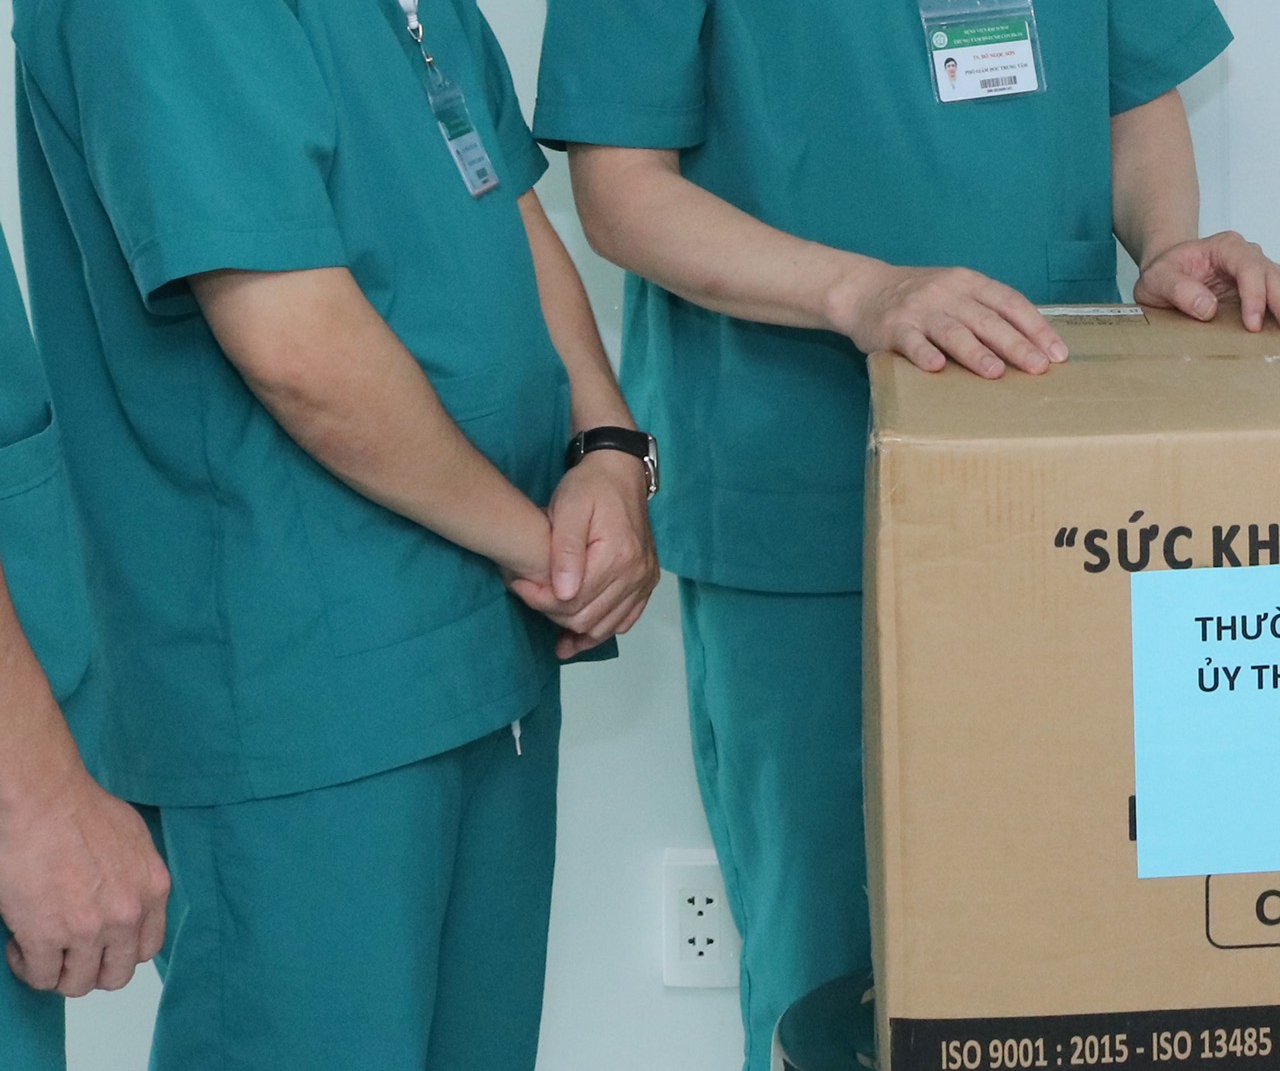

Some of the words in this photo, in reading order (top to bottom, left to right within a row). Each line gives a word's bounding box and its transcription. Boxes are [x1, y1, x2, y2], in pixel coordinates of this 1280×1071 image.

[1198, 657, 1242, 692] ỦY
[941, 1039, 982, 1070] ISO
[988, 1037, 1048, 1069] 9001
[1070, 1033, 1129, 1065] 2015
[1152, 1030, 1192, 1061] ISO
[1200, 1027, 1272, 1059] 13485
